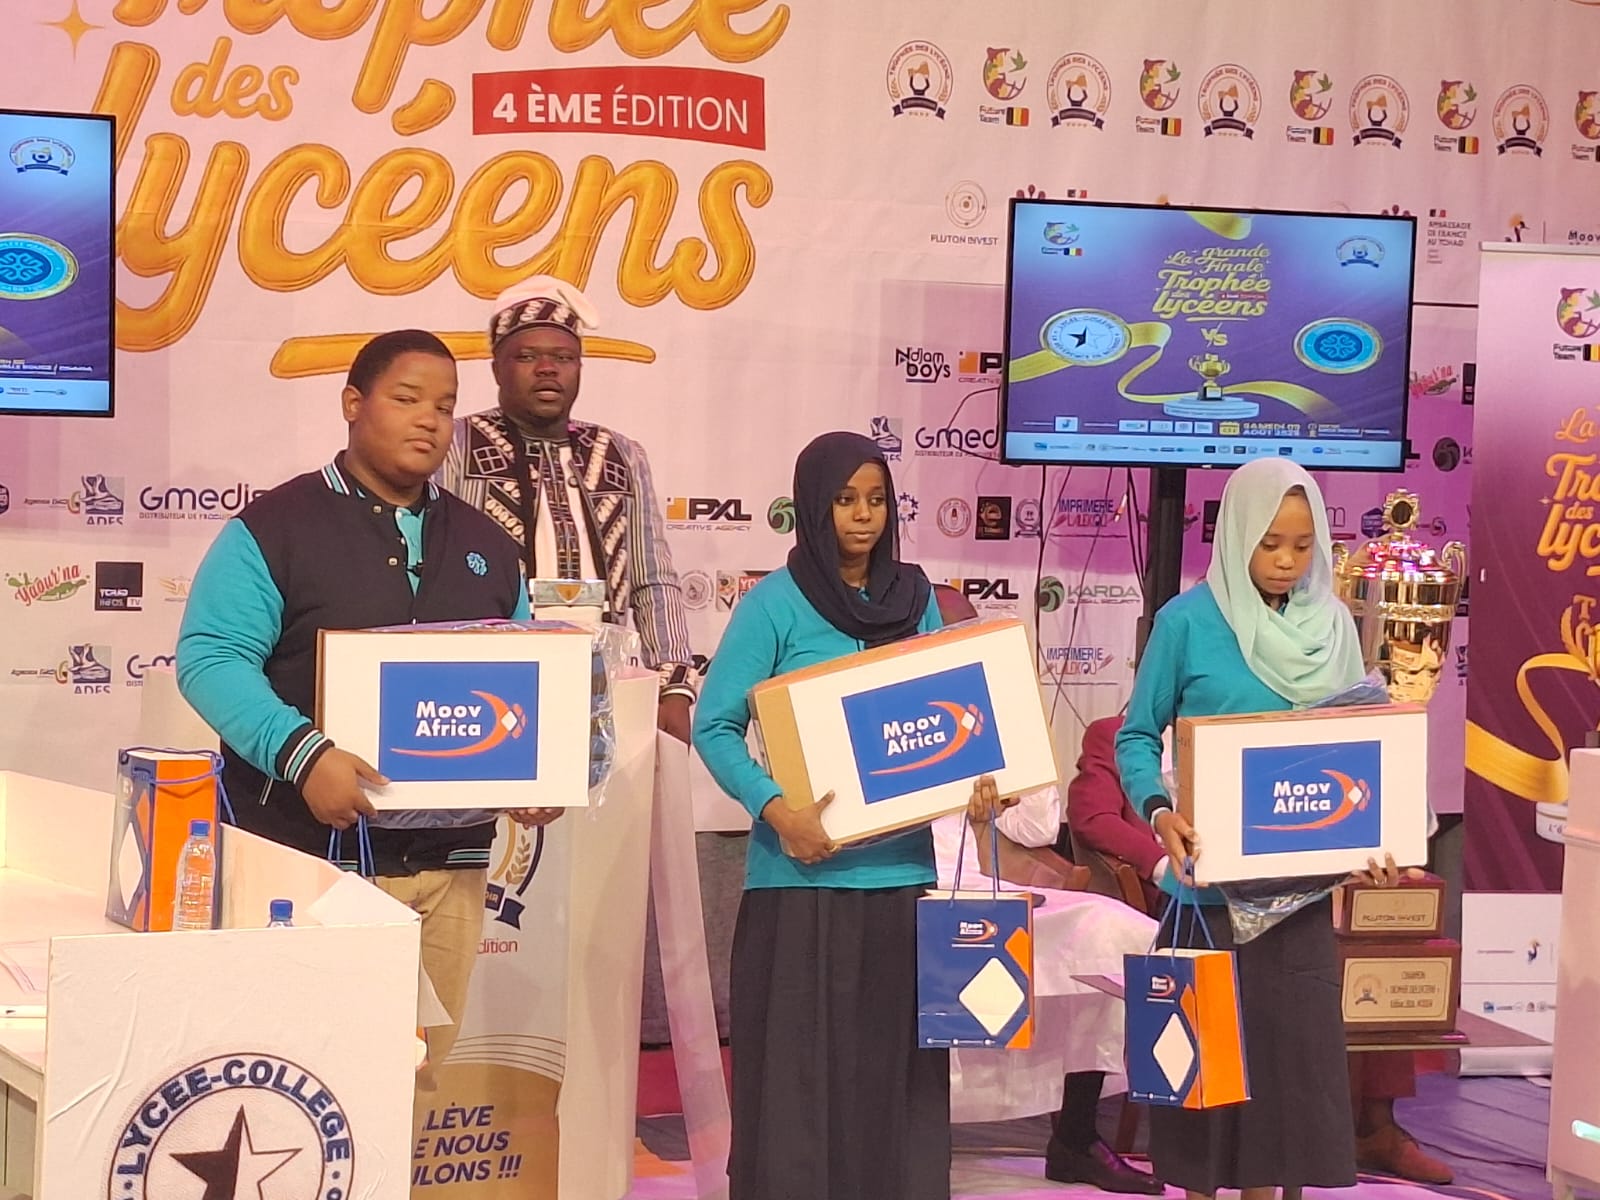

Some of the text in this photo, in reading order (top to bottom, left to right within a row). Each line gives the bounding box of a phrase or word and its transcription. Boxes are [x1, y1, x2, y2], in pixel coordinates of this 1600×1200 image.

[170, 36, 299, 121] des
[493, 82, 748, 134] 4 ÈME ÉDITION
[931, 234, 966, 243] PLUTON
[1158, 269, 1271, 297] Trophée
[1152, 290, 1268, 319] lycéens
[1554, 353, 1575, 361] Team
[906, 362, 951, 383] boys
[915, 426, 1000, 449] Gmed
[139, 483, 264, 510] Gmedi
[1059, 499, 1114, 513] IMPRIMERIE
[689, 498, 752, 521] PXL
[1565, 502, 1594, 519] des
[963, 578, 1019, 600] PXL
[1067, 585, 1140, 598] KARDA
[1046, 647, 1103, 661] IMPRIMERIE
[416, 701, 482, 718] Moov
[415, 718, 481, 737] Africa
[883, 713, 942, 740] Moov
[887, 731, 947, 757] Africa
[1273, 780, 1331, 798] Moov
[1273, 796, 1332, 814] Africa
[478, 937, 518, 954] dition
[425, 1102, 494, 1130] LÈVE
[433, 1131, 511, 1158] NOUS
